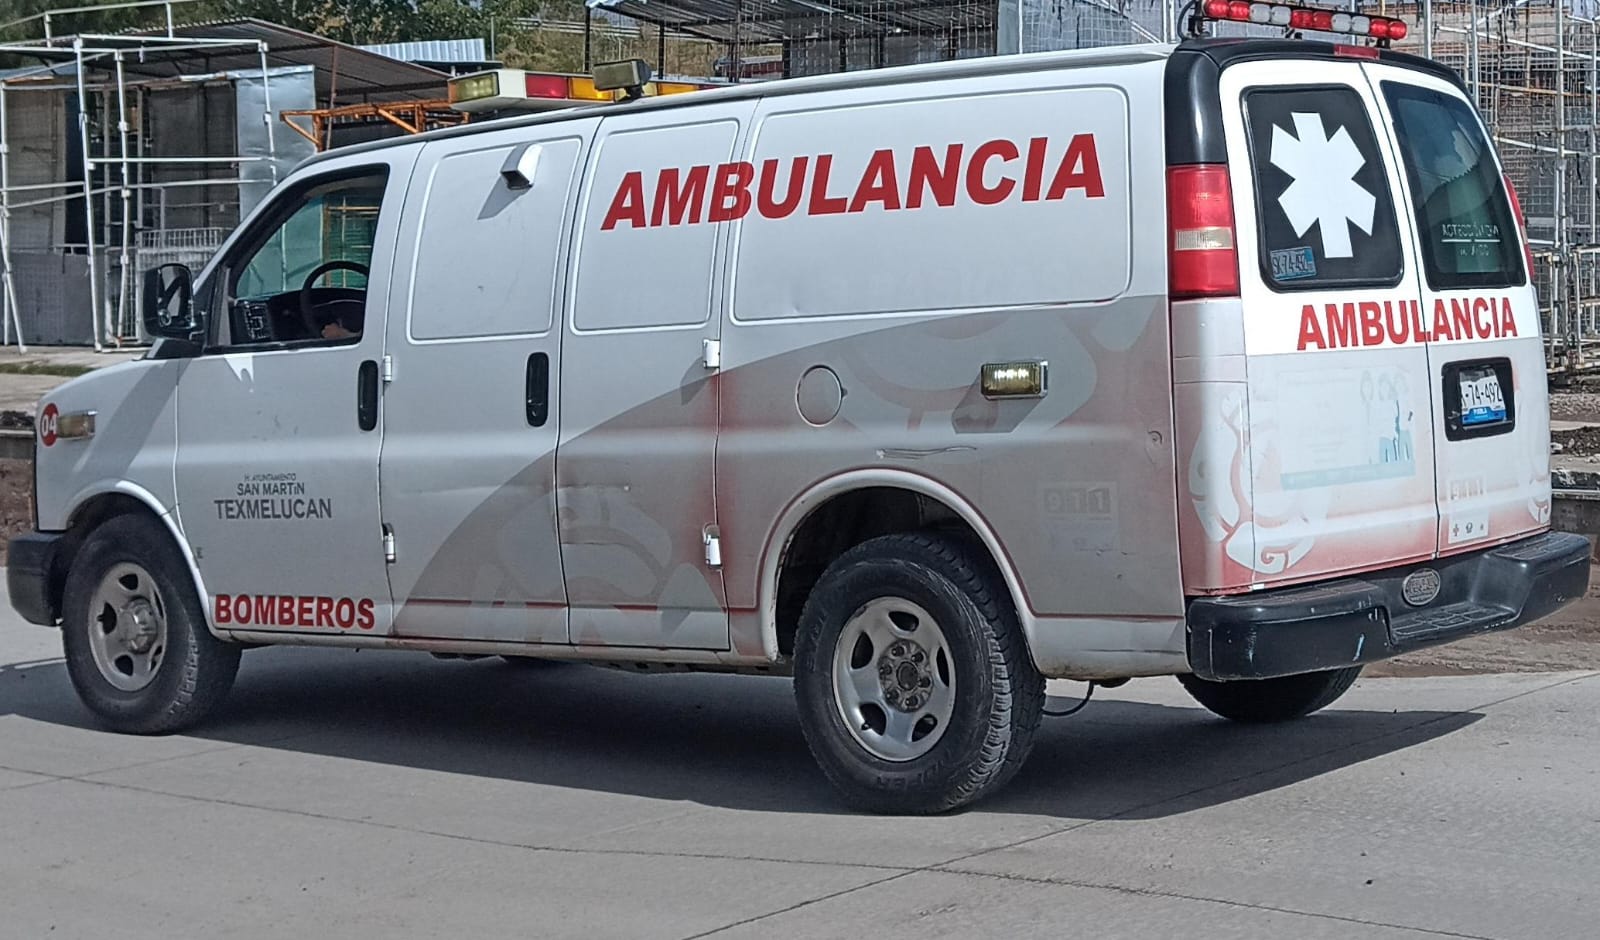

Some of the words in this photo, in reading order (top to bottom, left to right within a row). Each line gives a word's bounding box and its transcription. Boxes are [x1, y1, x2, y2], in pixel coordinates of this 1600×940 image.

[600, 132, 1105, 231] AMBULANCIA
[1297, 296, 1518, 350] AMBULANCIA
[41, 413, 58, 437] 04
[236, 482, 260, 496] SAN
[213, 498, 332, 520] TEXMELUCAN
[214, 593, 375, 630] BOMBEROS
